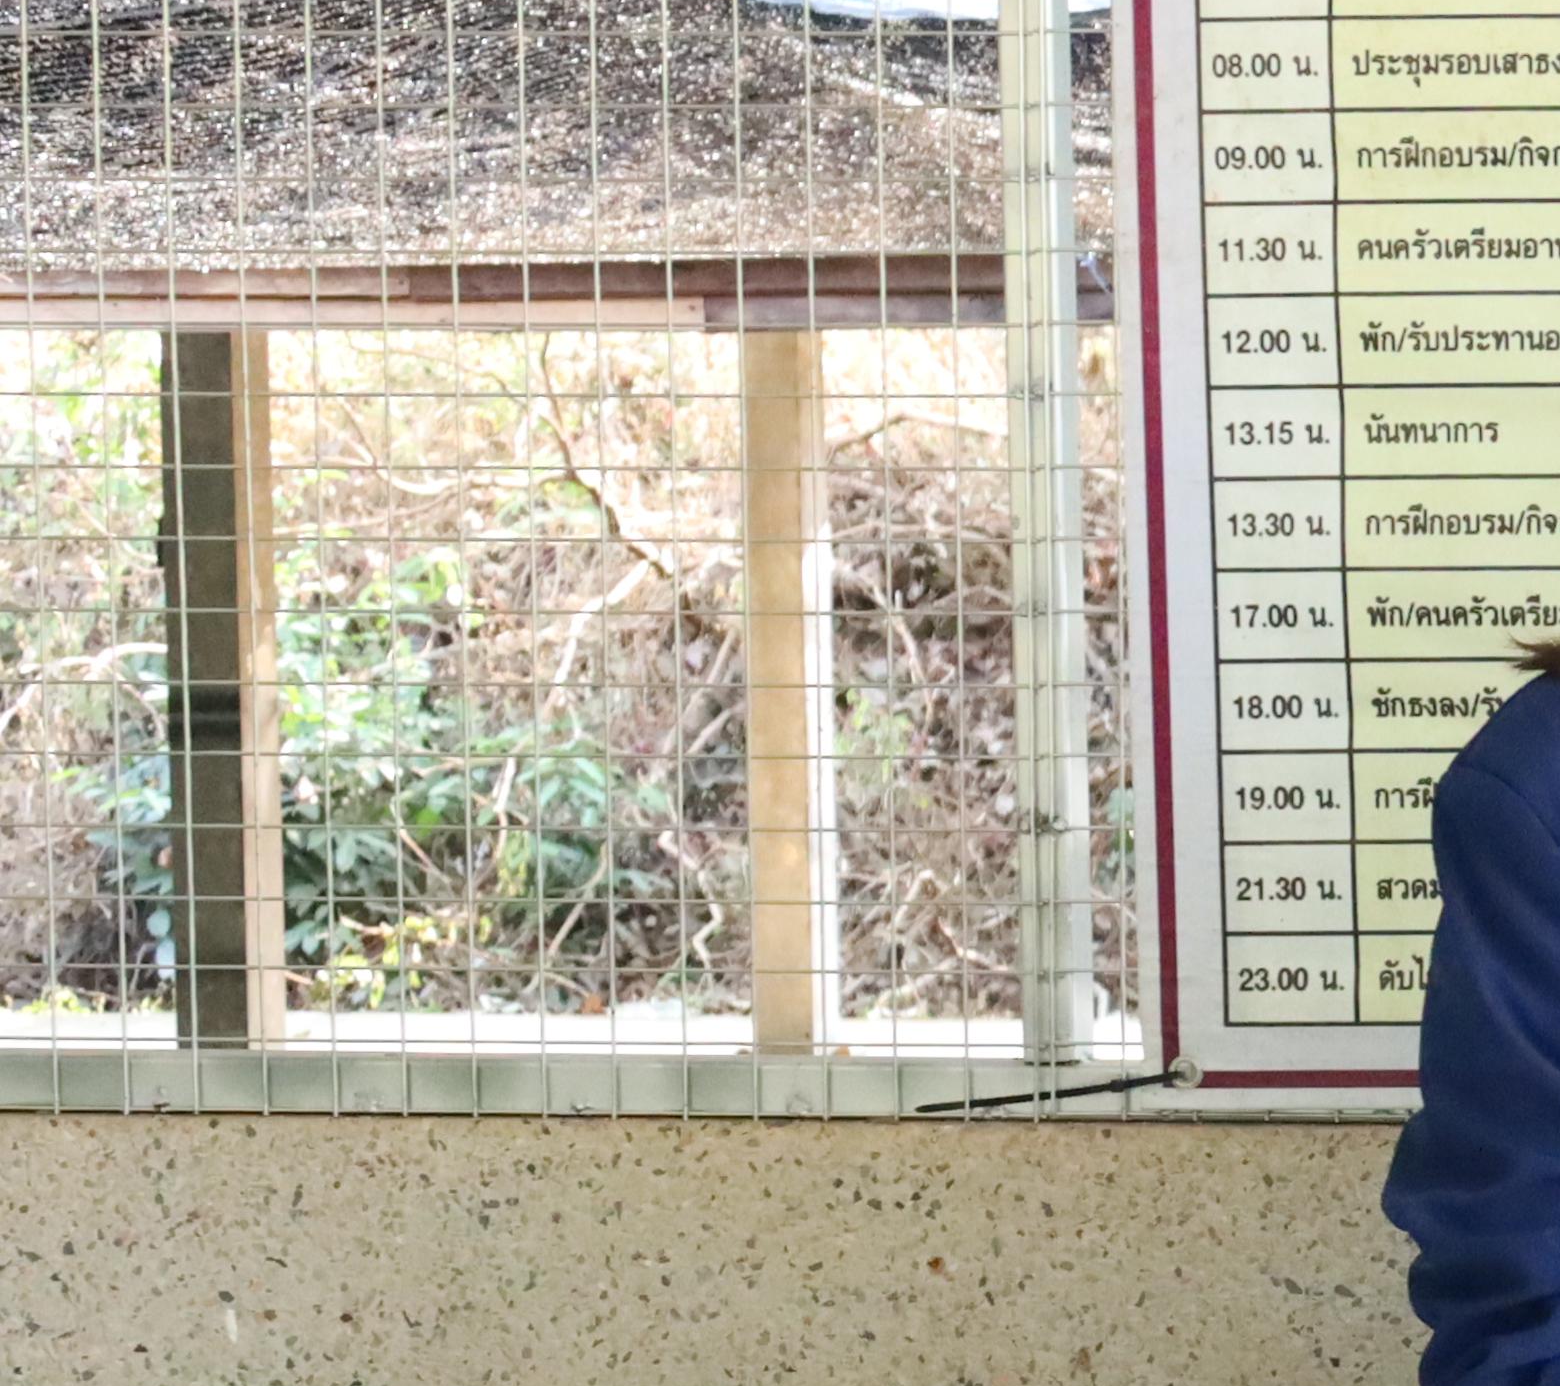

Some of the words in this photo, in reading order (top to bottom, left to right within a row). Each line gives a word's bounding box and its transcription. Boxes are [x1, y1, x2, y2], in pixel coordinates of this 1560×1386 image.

[1212, 52, 1282, 79] 08.00
[1292, 55, 1319, 77] น.
[1214, 145, 1286, 171] 09.00
[1296, 148, 1323, 169] น.
[1218, 237, 1287, 262] 11.30
[1297, 239, 1323, 261] น.
[1221, 329, 1291, 354] 12.00
[1301, 332, 1327, 353] น.
[1224, 420, 1294, 446] 13.15
[1304, 423, 1330, 445] น.
[1364, 412, 1499, 444] นันทนาการ
[1227, 512, 1295, 537] 13.30
[1305, 515, 1331, 536] น.
[1230, 604, 1298, 629] 17.00
[1308, 606, 1334, 628] น.
[1233, 694, 1303, 720] 18.00
[1313, 697, 1339, 718] น.
[1371, 686, 1503, 718] ชักธงลง/รั
[1235, 785, 1305, 811] 19.00
[1315, 788, 1341, 810] น.
[1236, 876, 1307, 902] 21.30
[1316, 879, 1343, 901] น.
[1238, 967, 1309, 992] 23.00
[1319, 970, 1345, 991] น.
